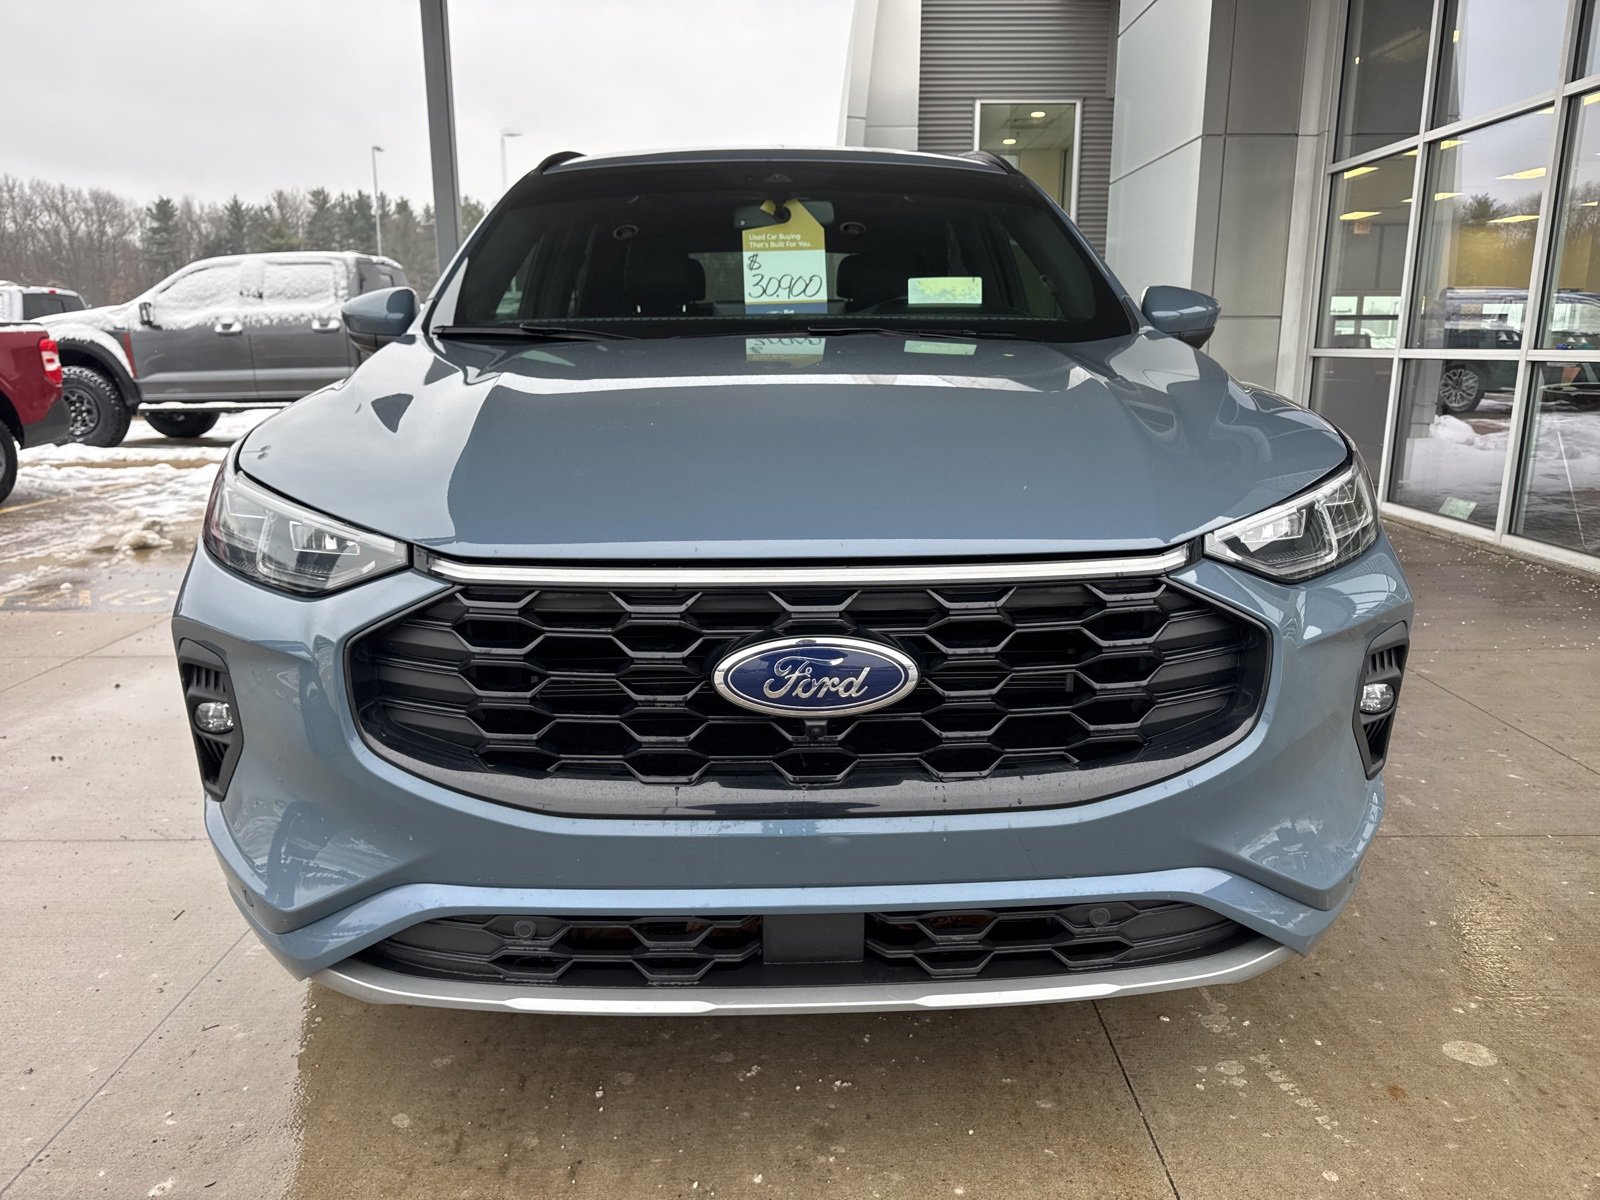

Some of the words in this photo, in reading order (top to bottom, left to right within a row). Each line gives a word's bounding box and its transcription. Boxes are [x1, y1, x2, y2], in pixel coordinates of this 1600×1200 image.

[779, 233, 801, 241] Buying
[747, 253, 761, 271] $
[762, 655, 871, 699] Ford
